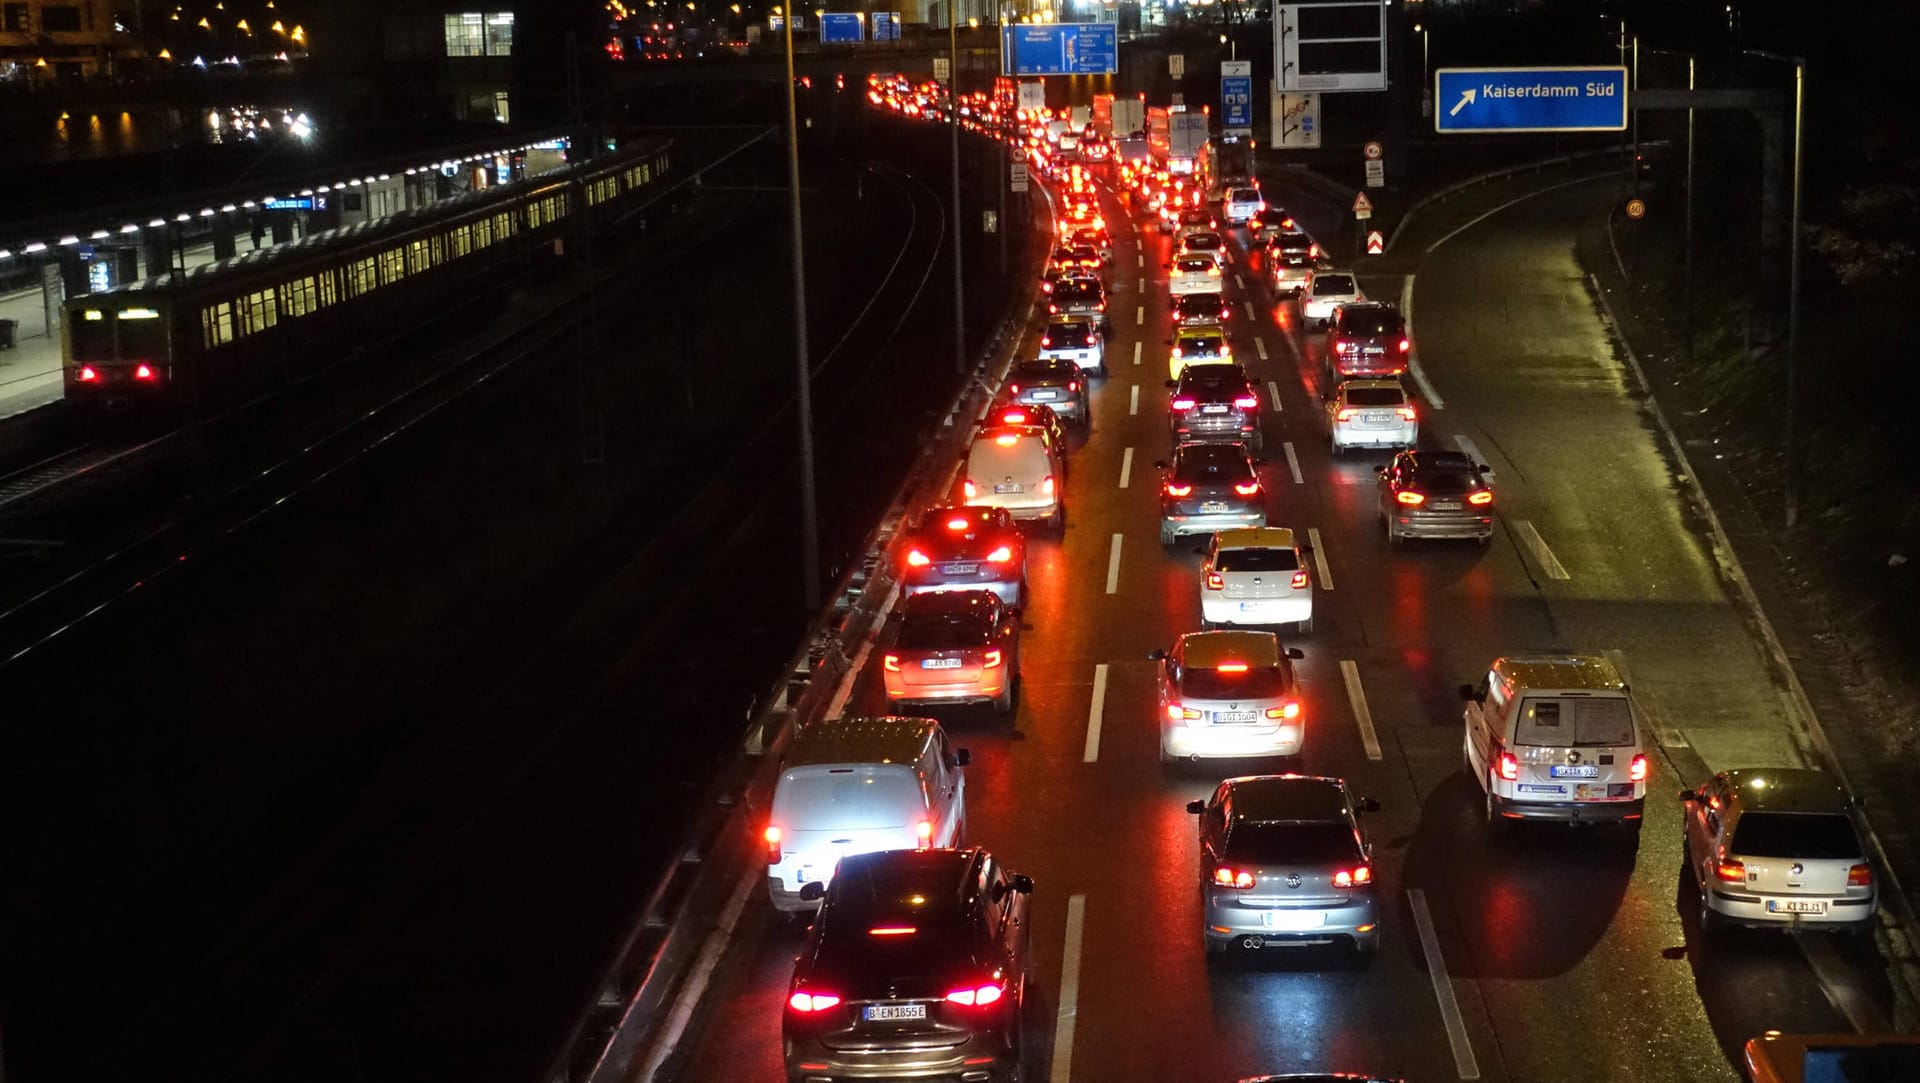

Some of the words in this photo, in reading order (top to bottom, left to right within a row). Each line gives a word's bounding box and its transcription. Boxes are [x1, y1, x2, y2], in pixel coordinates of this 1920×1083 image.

[1483, 84, 1579, 98] Kaiserdamm
[1586, 82, 1615, 97] Süd
[318, 198, 326, 209] 2
[1631, 204, 1641, 214] 60
